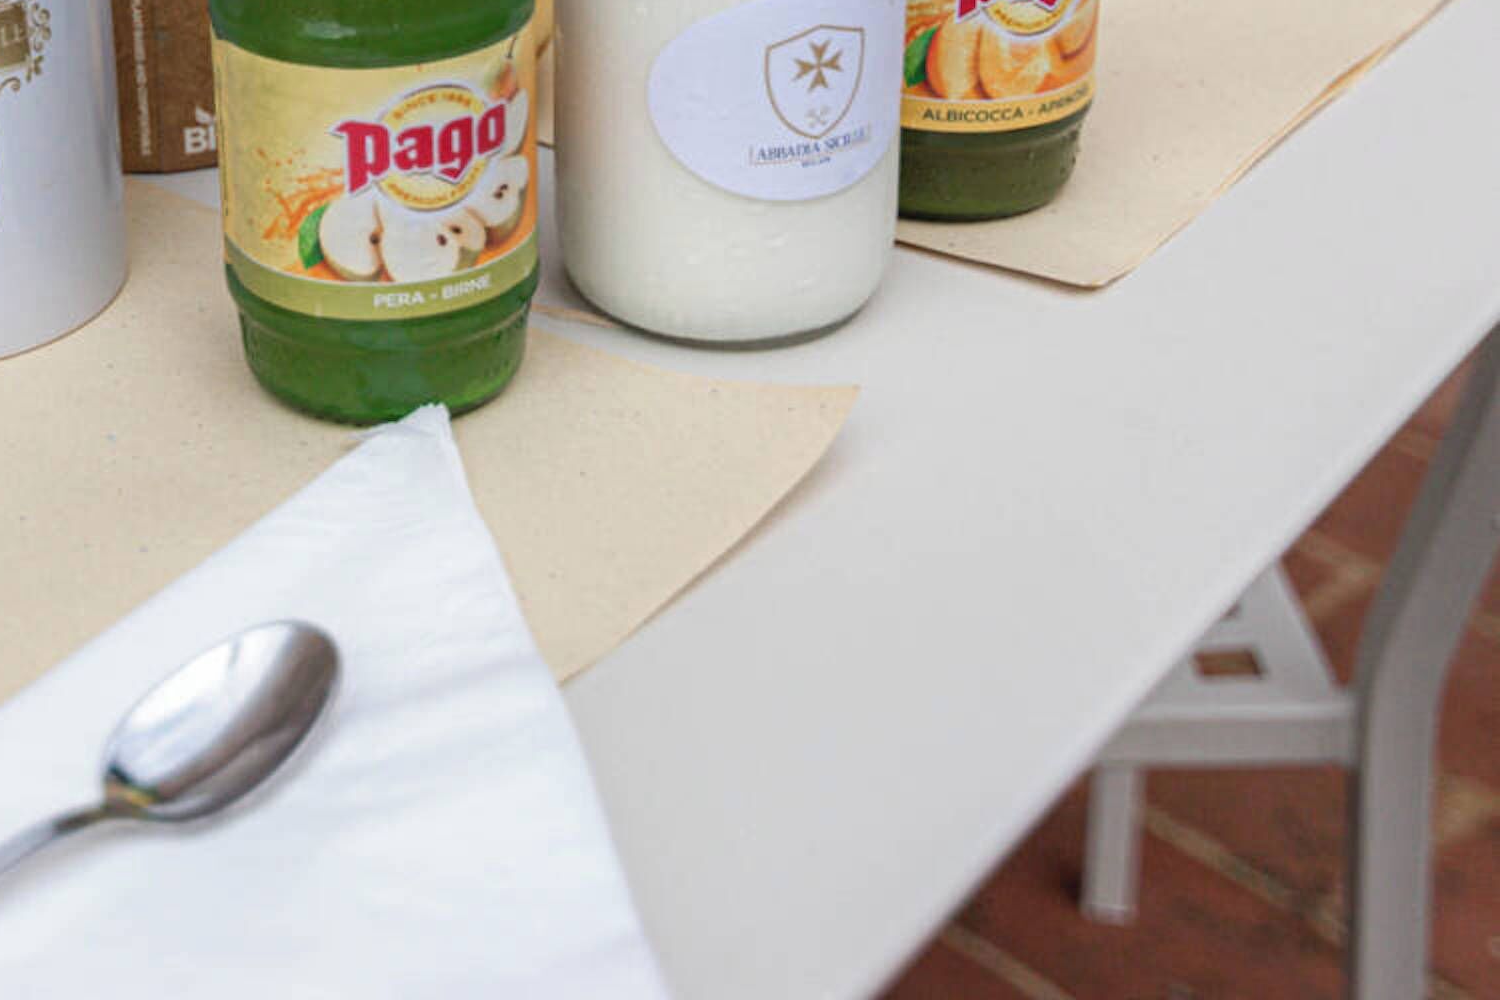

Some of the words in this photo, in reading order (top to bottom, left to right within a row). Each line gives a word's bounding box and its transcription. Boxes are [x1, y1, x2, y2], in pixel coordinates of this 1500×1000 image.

[922, 107, 1024, 122] ALBICOCCA
[335, 104, 505, 192] pago
[373, 290, 424, 309] PERA
